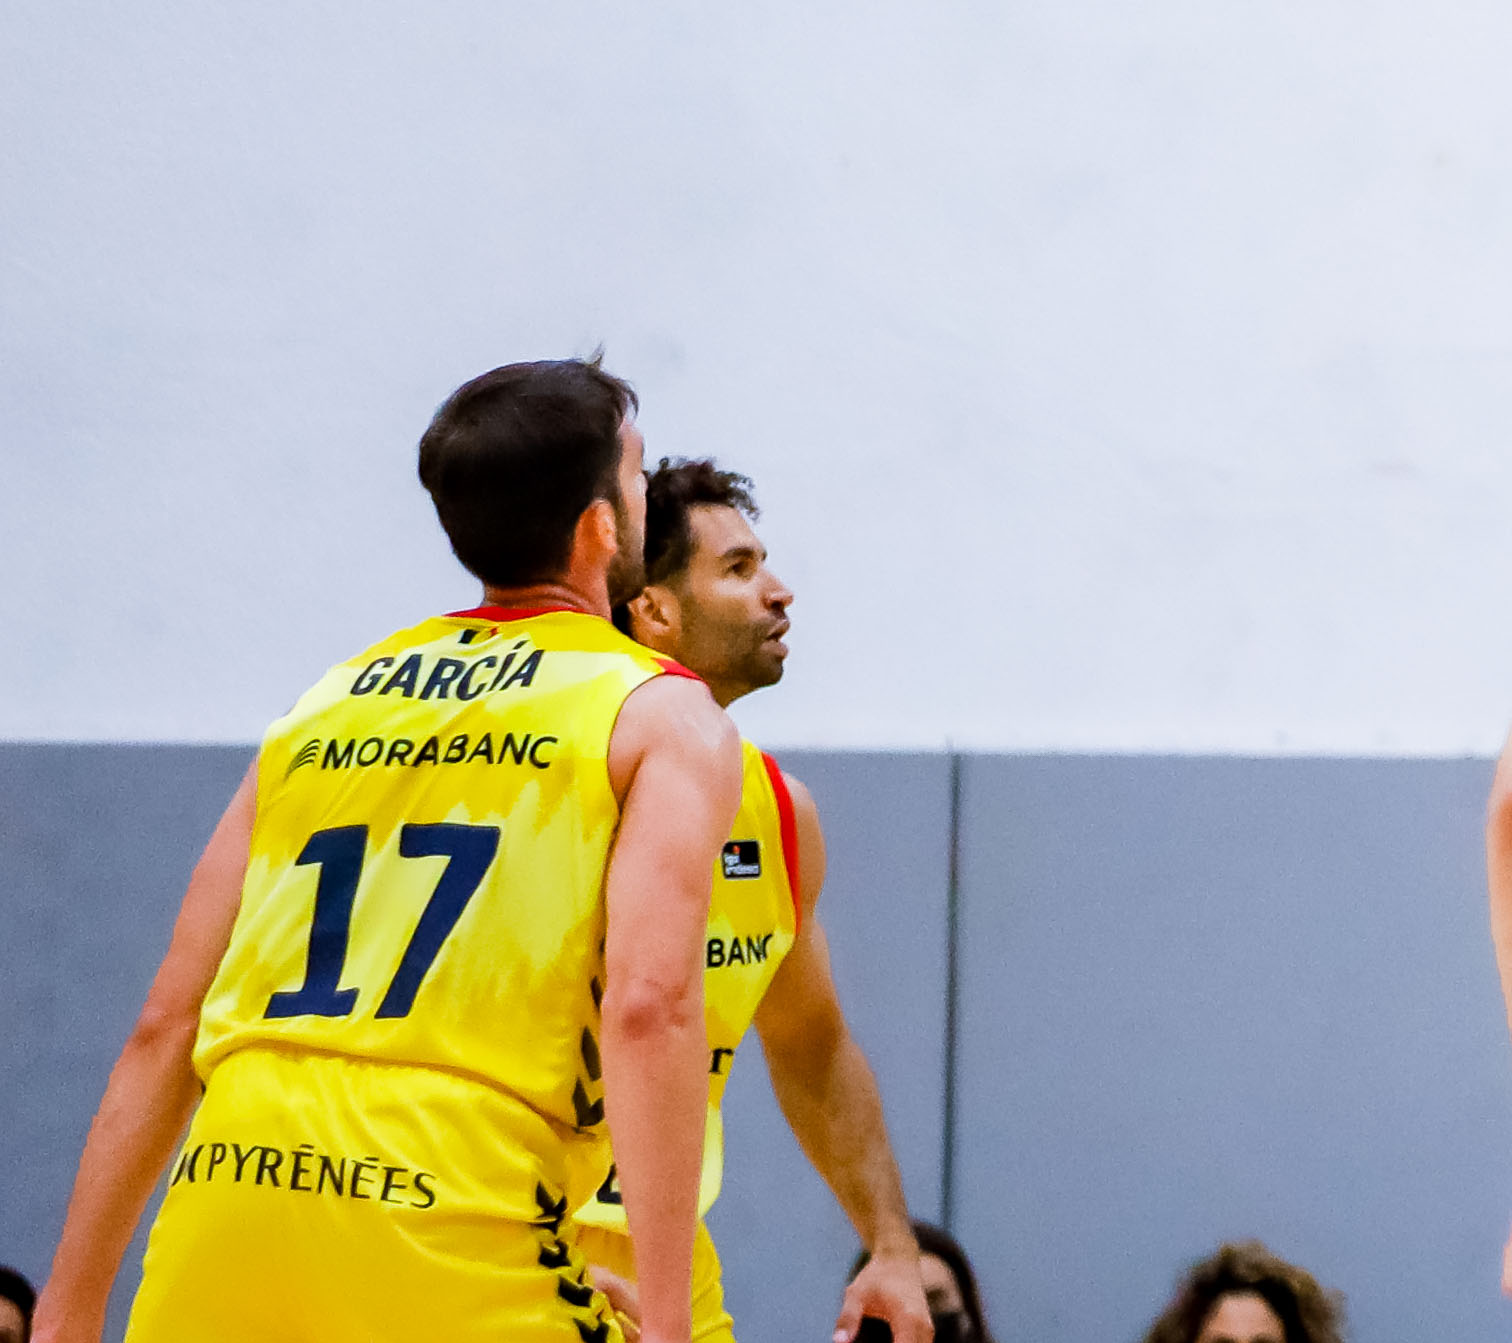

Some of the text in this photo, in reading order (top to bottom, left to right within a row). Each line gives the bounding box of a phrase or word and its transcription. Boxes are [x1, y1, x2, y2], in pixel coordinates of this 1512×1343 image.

[350, 640, 545, 701] GARCÍA
[321, 732, 558, 770] MORABANC
[263, 822, 500, 1020] 17
